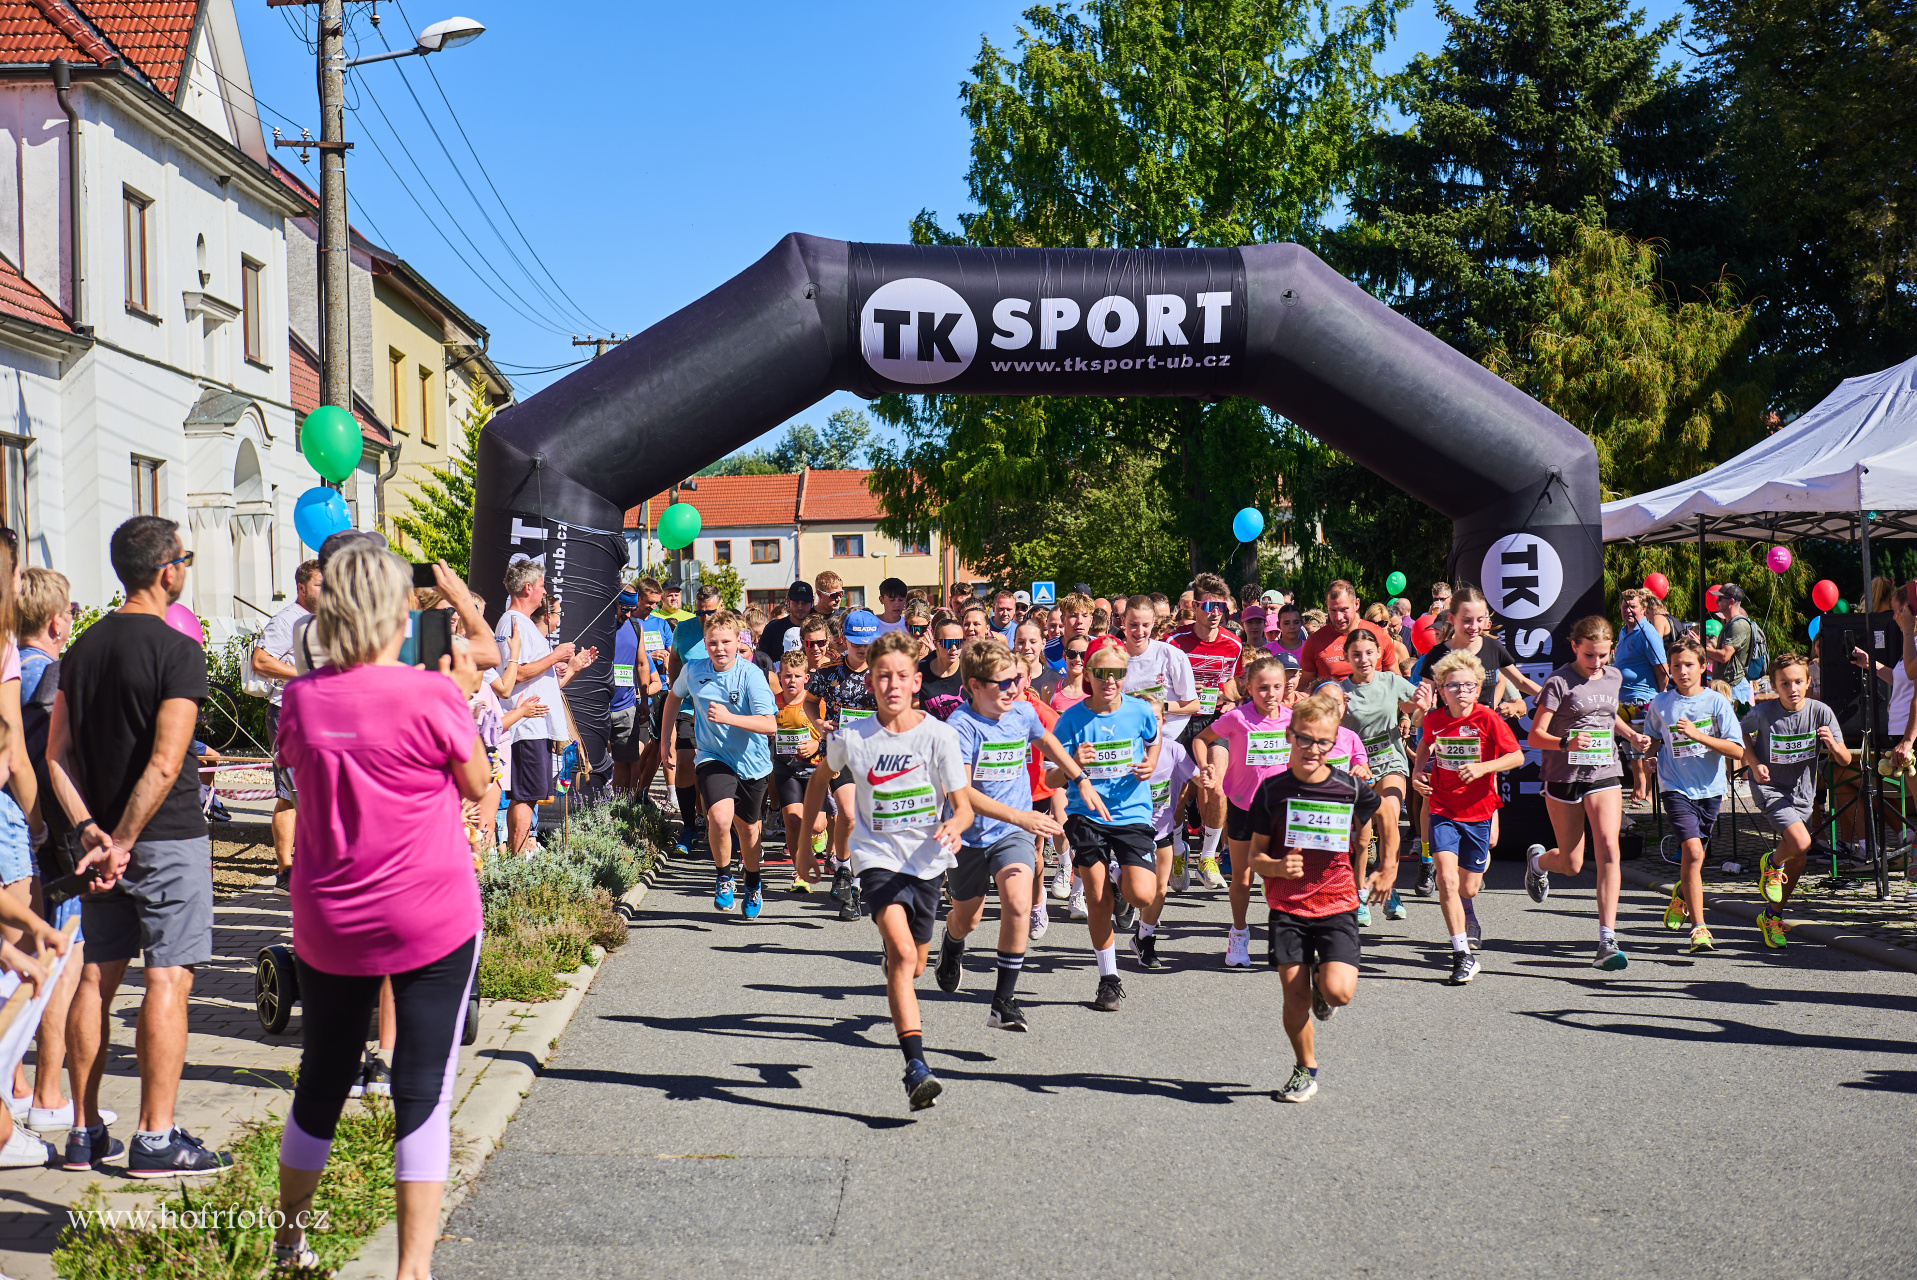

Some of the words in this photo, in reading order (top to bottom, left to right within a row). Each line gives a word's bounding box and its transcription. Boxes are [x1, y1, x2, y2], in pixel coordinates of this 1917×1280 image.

[873, 308, 963, 364] TK
[991, 291, 1232, 350] SPORT
[991, 353, 1231, 373] www.tksport-ub.cz
[1501, 544, 1540, 610] TK
[1263, 740, 1279, 749] 251
[1447, 745, 1465, 755] 226
[1785, 741, 1802, 750] 338
[996, 751, 1014, 761] 373
[1098, 750, 1117, 761] 505
[874, 754, 913, 772] NIKE
[892, 799, 915, 811] 379
[1308, 813, 1331, 826] 244
